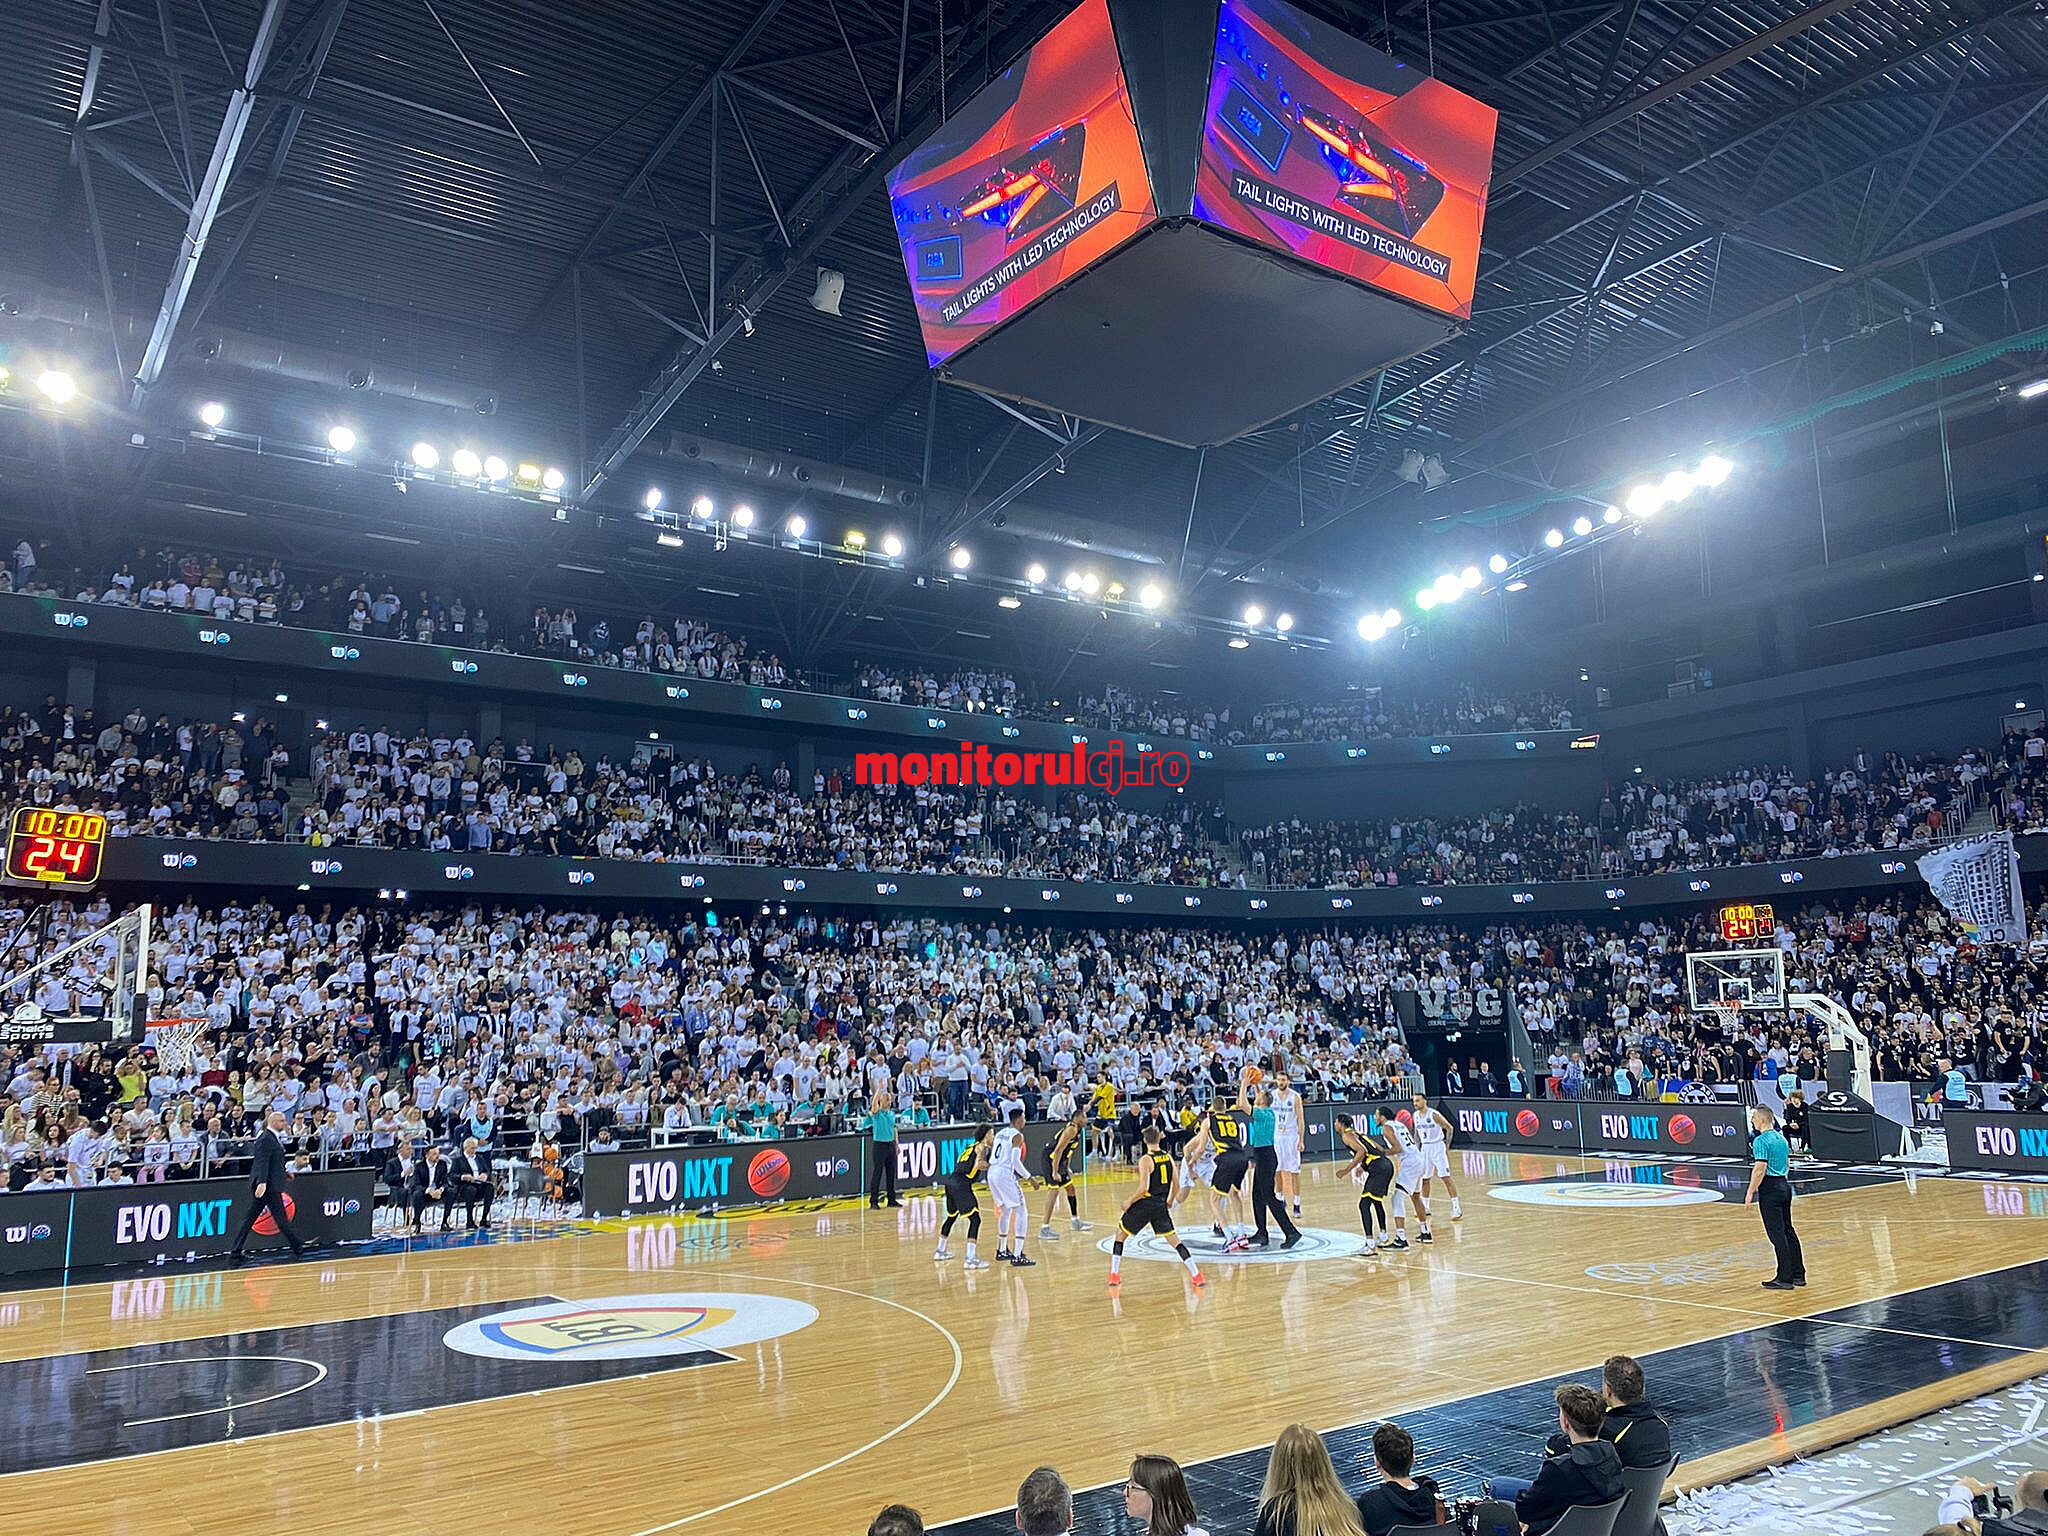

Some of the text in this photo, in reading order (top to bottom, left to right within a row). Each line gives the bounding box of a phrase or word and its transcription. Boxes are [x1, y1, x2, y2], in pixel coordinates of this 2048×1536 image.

[1236, 178, 1447, 275] TAIL LIGHTS WITH LED TECHNOLOGY
[942, 191, 1116, 321] TAIL LIGHTS WITH LED TECHNOLOGY
[28, 811, 103, 840] 10:00
[26, 838, 85, 873] 24
[1725, 906, 1753, 920] 10:00
[1729, 918, 1772, 937] 24 24
[1217, 1120, 1238, 1138] 18
[1458, 1110, 1508, 1134] EVO NXT
[1601, 1114, 1659, 1140] EVO NXT
[1975, 1126, 2048, 1157] EVO NX
[897, 1140, 937, 1180] EVO
[628, 1156, 733, 1204] EVO NXT
[116, 1199, 232, 1244] EVO NXT
